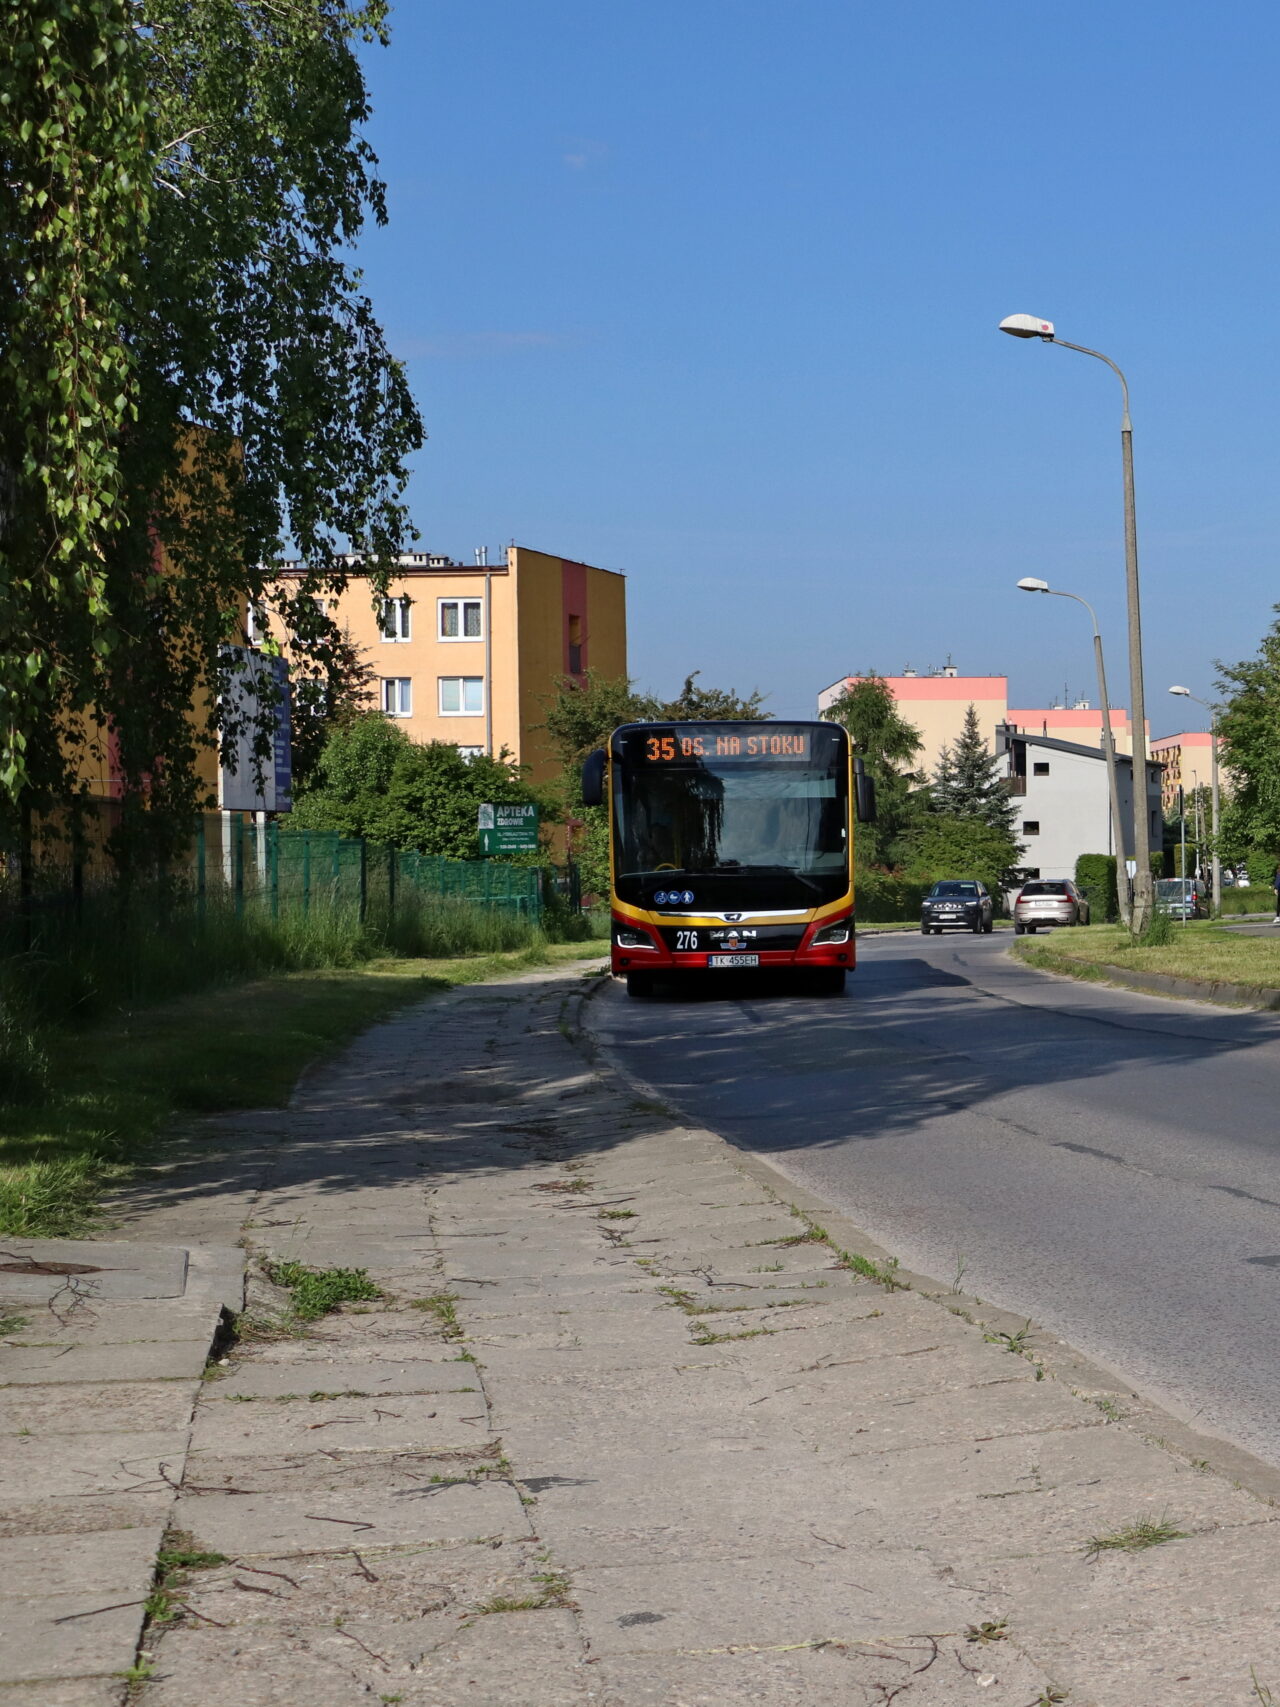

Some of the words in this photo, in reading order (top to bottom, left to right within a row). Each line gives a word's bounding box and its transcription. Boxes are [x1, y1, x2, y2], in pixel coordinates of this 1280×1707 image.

[647, 738, 675, 760] 35
[681, 738, 710, 756] OS.
[716, 736, 740, 755] NA
[747, 735, 804, 755] STOKU
[497, 805, 535, 817] APTEKA
[497, 818, 524, 826] ZDROWIE
[710, 930, 757, 938] MAN
[676, 931, 698, 949] 276
[713, 956, 726, 965] TK
[729, 955, 757, 965] 455EH
